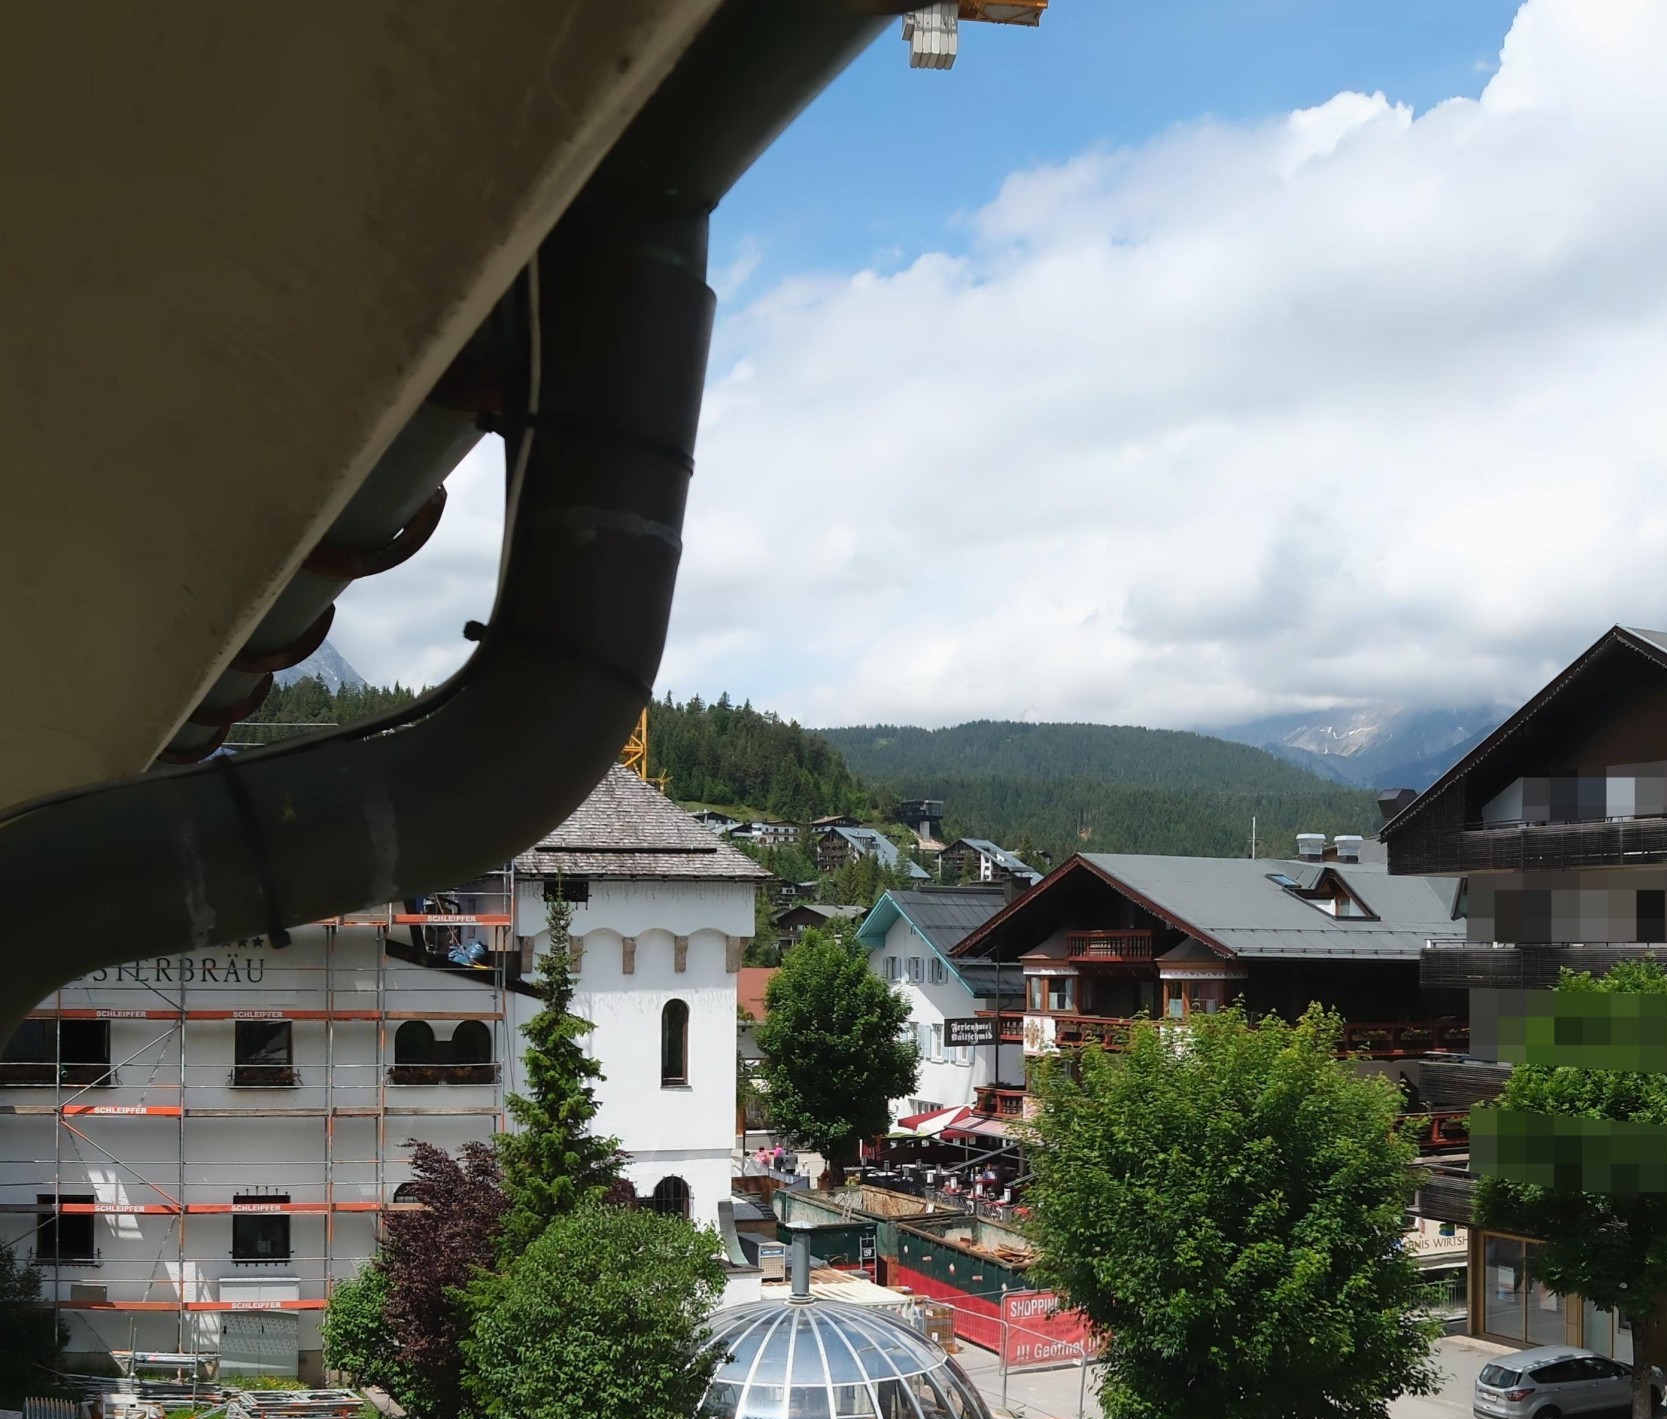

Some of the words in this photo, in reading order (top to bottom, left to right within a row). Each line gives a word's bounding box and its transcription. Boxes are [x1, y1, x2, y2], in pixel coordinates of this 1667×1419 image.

[427, 914, 477, 922] SCHLEIPFER
[96, 1010, 147, 1018] SCHLEIPFER
[233, 1010, 283, 1018] SCHLEIPFER
[94, 1106, 147, 1114] SCHLEIPFER
[95, 1205, 145, 1213] SCHLEIPFER
[231, 1204, 281, 1212] SCHLEIPFER
